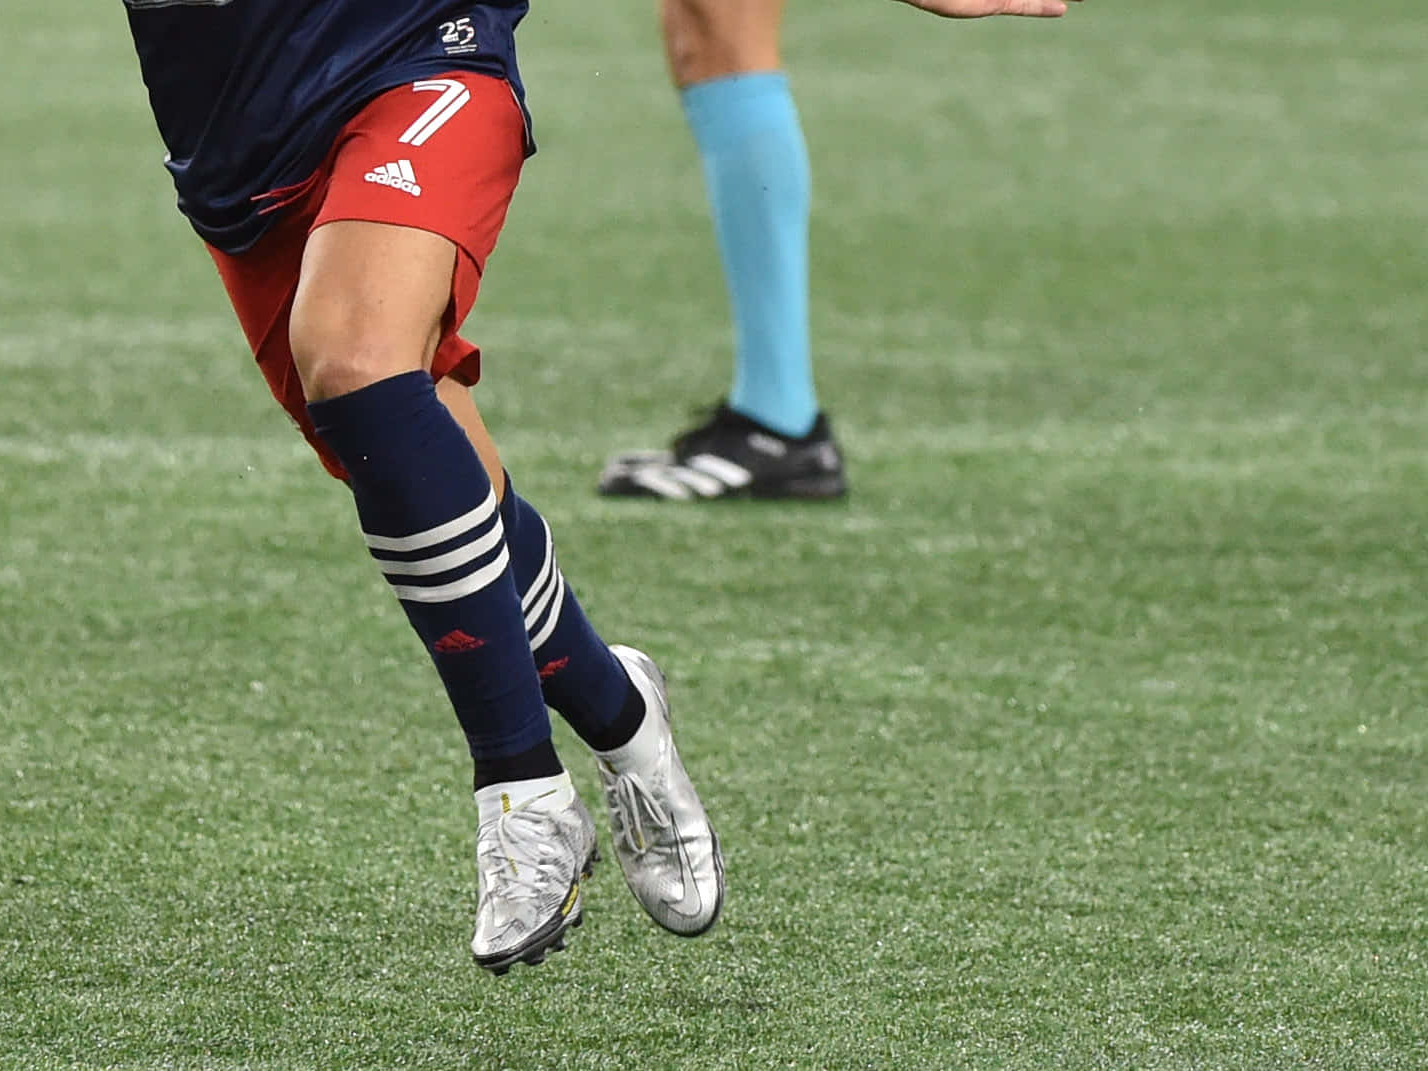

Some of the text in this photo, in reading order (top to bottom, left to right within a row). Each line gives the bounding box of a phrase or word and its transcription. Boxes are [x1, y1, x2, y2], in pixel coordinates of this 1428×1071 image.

[438, 17, 475, 45] 25
[397, 79, 471, 147] 7
[363, 172, 422, 197] adidas
